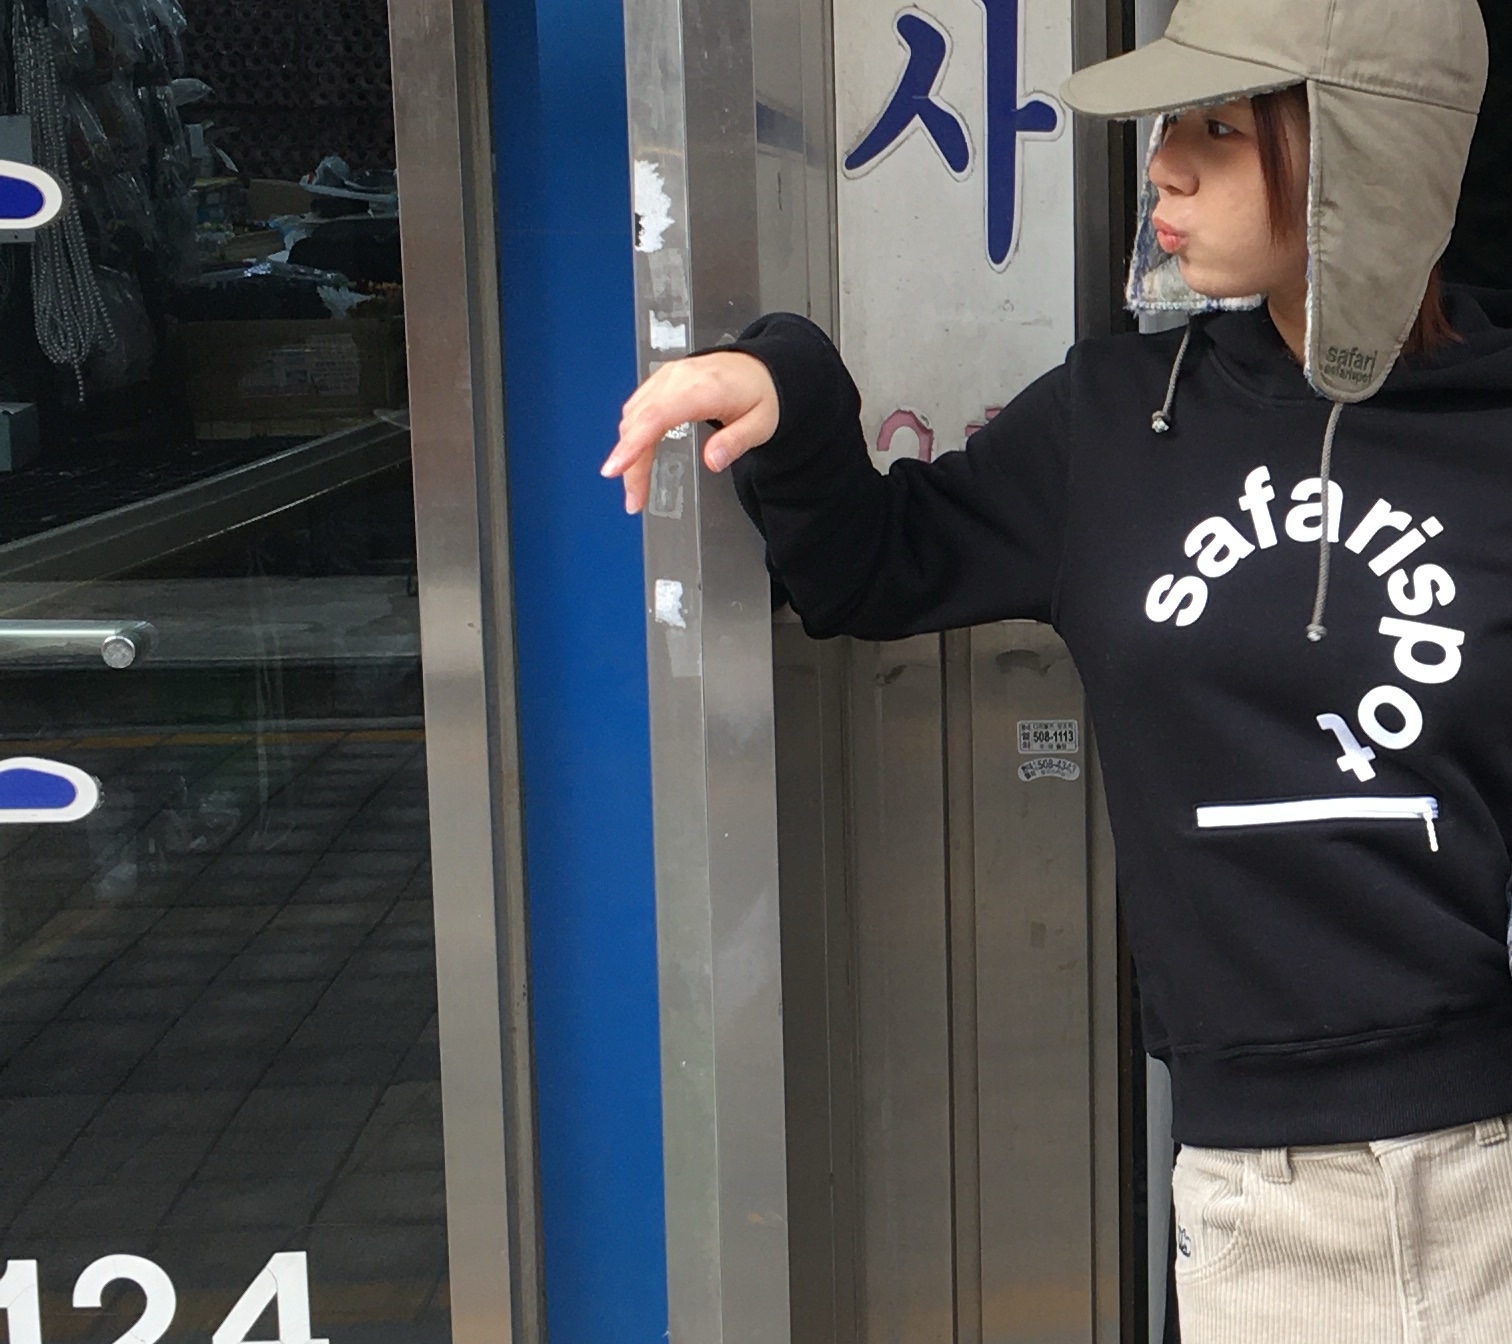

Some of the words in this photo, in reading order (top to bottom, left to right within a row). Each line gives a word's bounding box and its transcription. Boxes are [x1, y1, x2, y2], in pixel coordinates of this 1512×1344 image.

[1325, 346, 1378, 371] safari
[1144, 465, 1466, 783] safarispot
[1033, 730, 1074, 743] 508-1113
